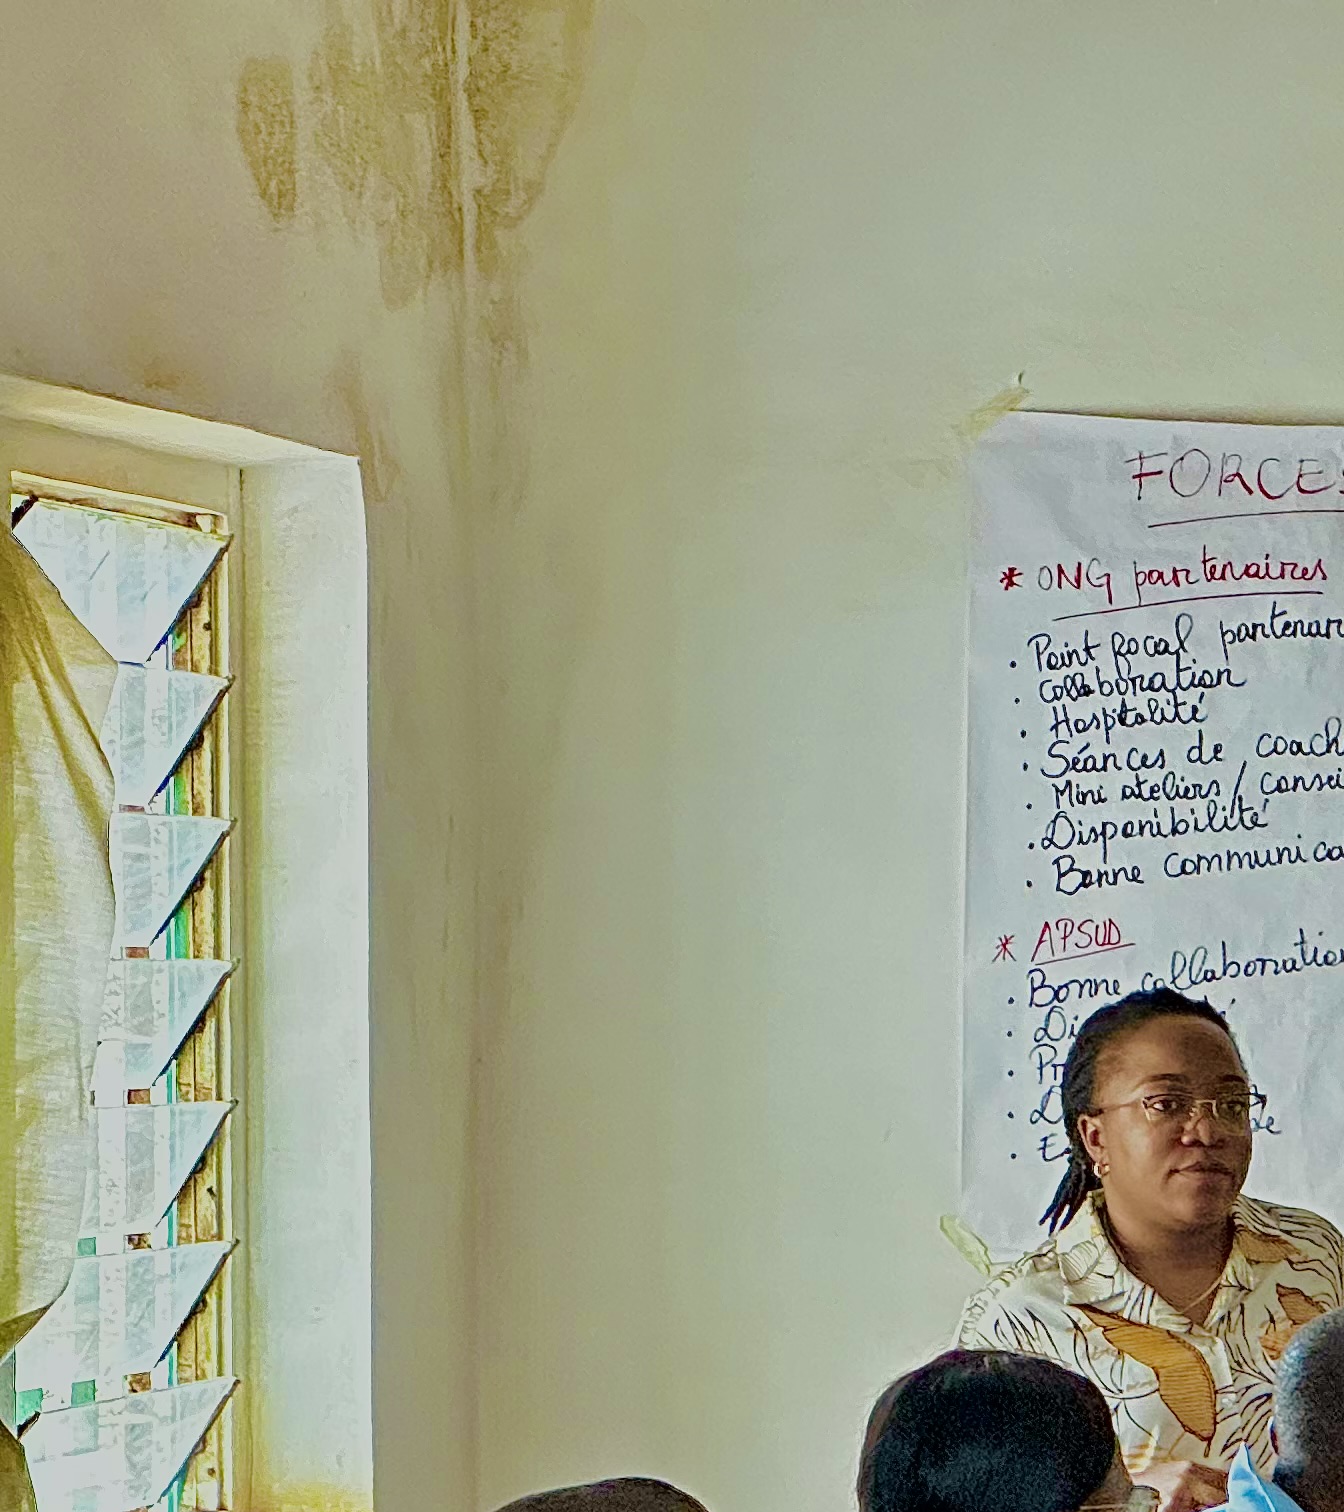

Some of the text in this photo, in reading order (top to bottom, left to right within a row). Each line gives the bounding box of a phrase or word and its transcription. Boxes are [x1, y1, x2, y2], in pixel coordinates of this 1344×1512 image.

[1037, 544, 1329, 606] ONG partenaires
[1028, 631, 1101, 673] Point
[1112, 613, 1194, 669] focal
[1040, 739, 1167, 779] Séances
[1187, 731, 1223, 764] de
[1054, 782, 1108, 809] Mini
[1041, 798, 1269, 863] Disponibilité
[1053, 854, 1144, 896] Bonne
[1031, 918, 1123, 962] APSUD
[1027, 968, 1121, 1009] Bonne
